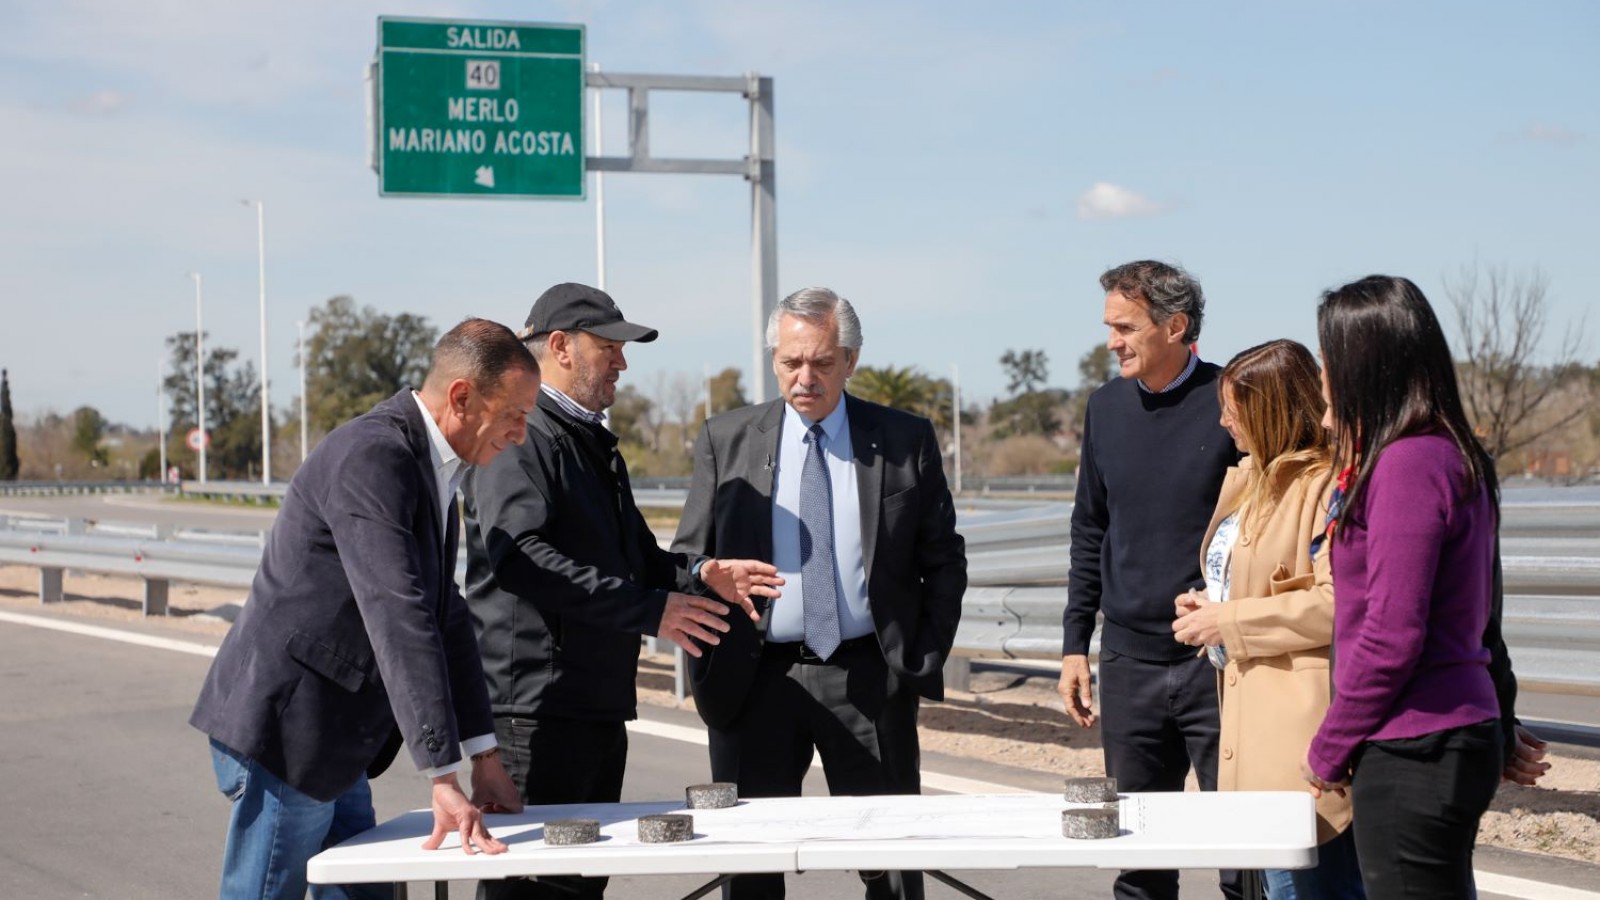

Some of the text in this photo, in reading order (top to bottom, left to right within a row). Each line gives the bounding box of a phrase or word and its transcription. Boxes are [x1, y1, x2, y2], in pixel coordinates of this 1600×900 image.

[447, 27, 521, 49] SALIDA
[470, 64, 497, 86] 40
[448, 97, 519, 122] MERLO
[389, 127, 574, 155] MARIANO ACOSTA
